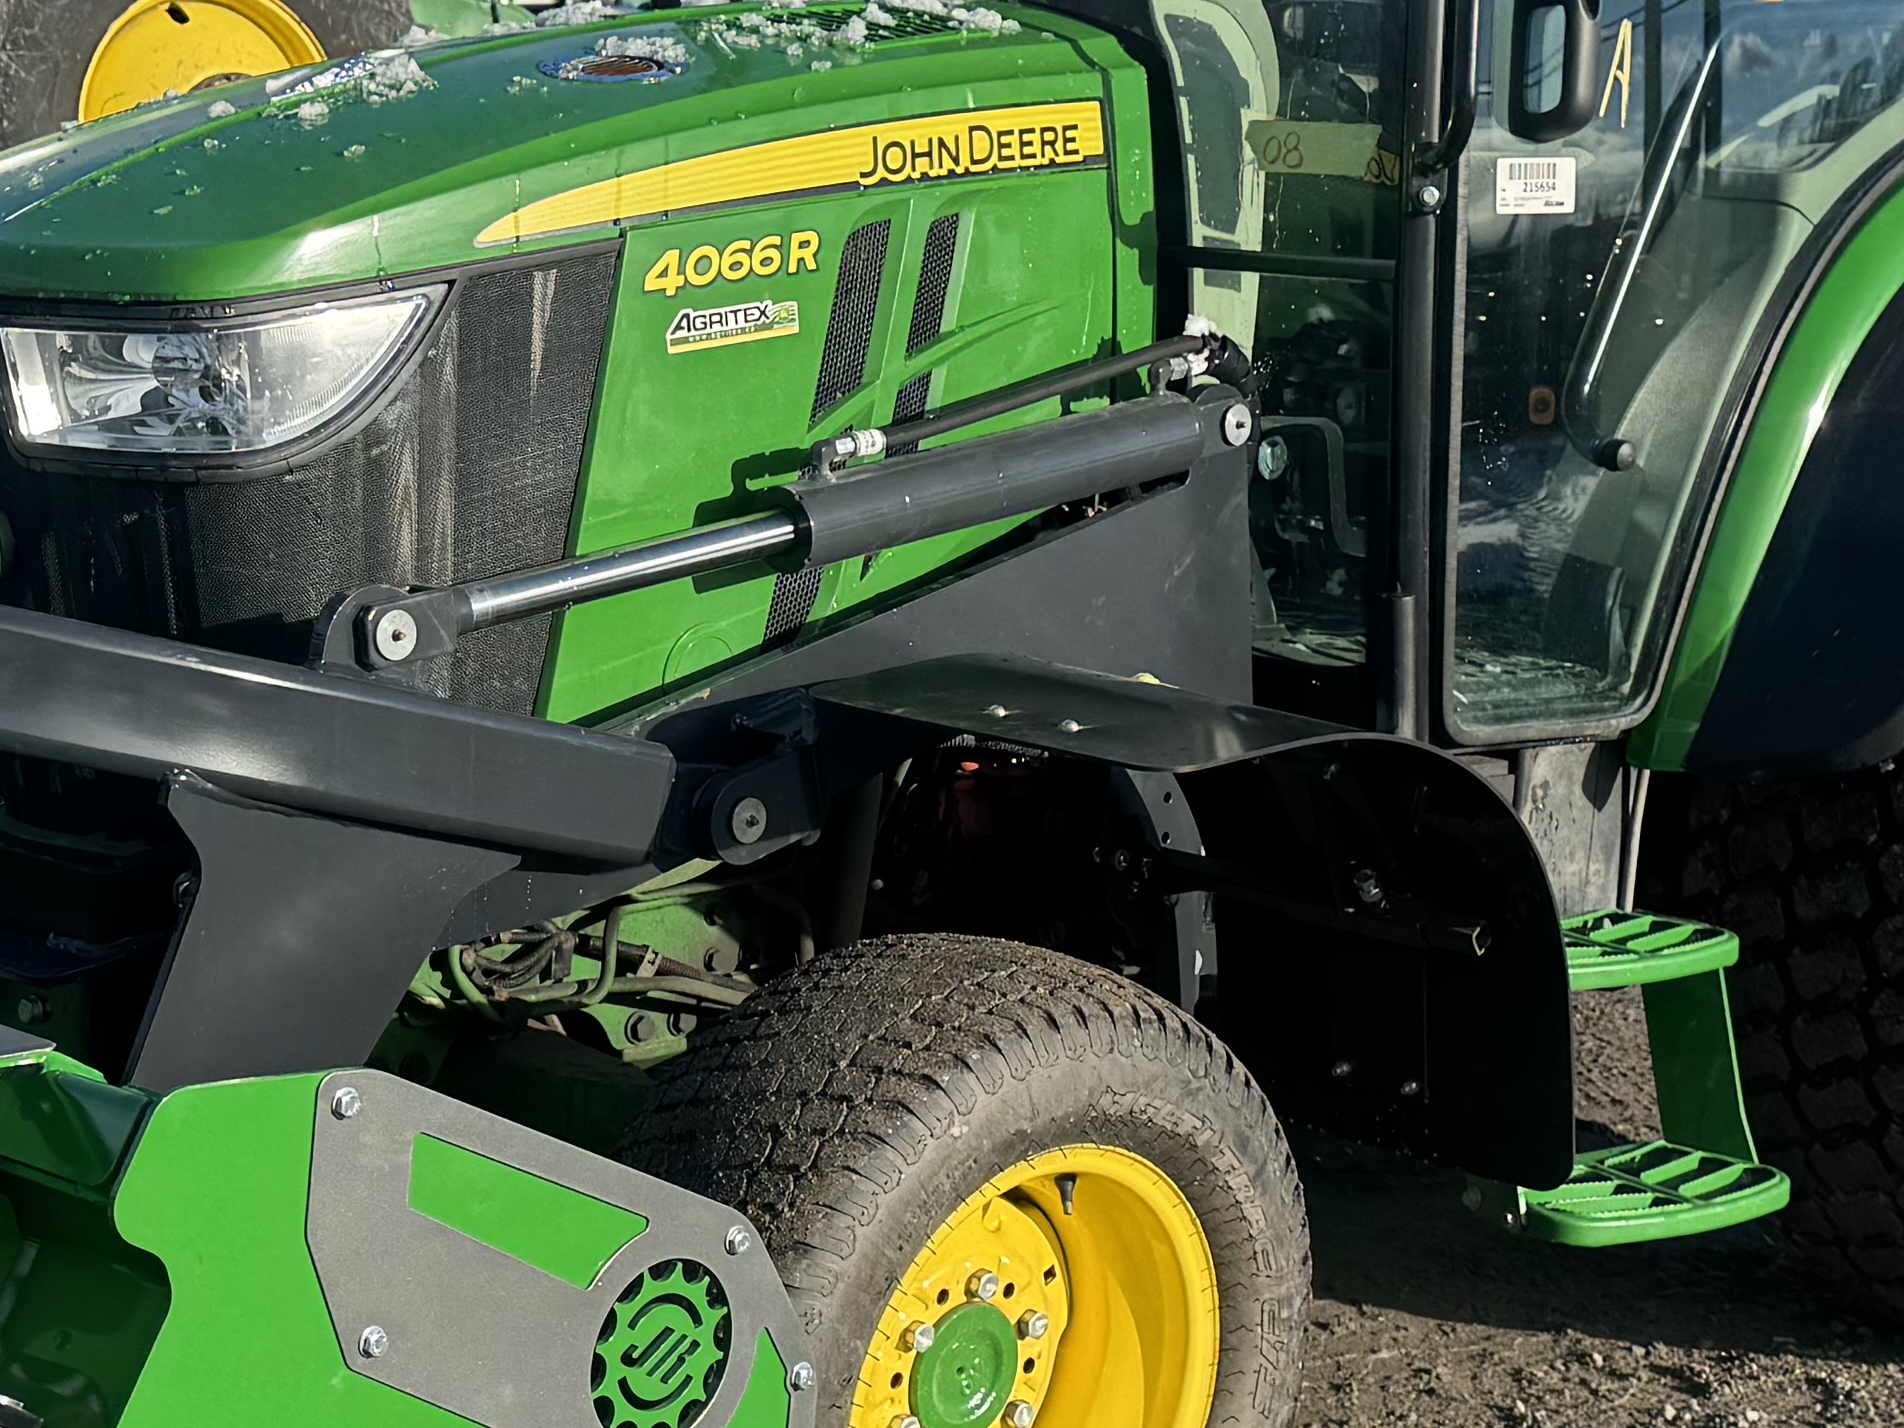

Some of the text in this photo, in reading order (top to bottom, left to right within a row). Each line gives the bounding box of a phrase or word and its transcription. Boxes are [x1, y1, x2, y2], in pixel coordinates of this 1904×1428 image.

[1599, 18, 1633, 128] A
[859, 123, 1081, 180] JOHN DEERE
[1262, 131, 1304, 170] 08
[670, 303, 772, 336] AGRITEX
